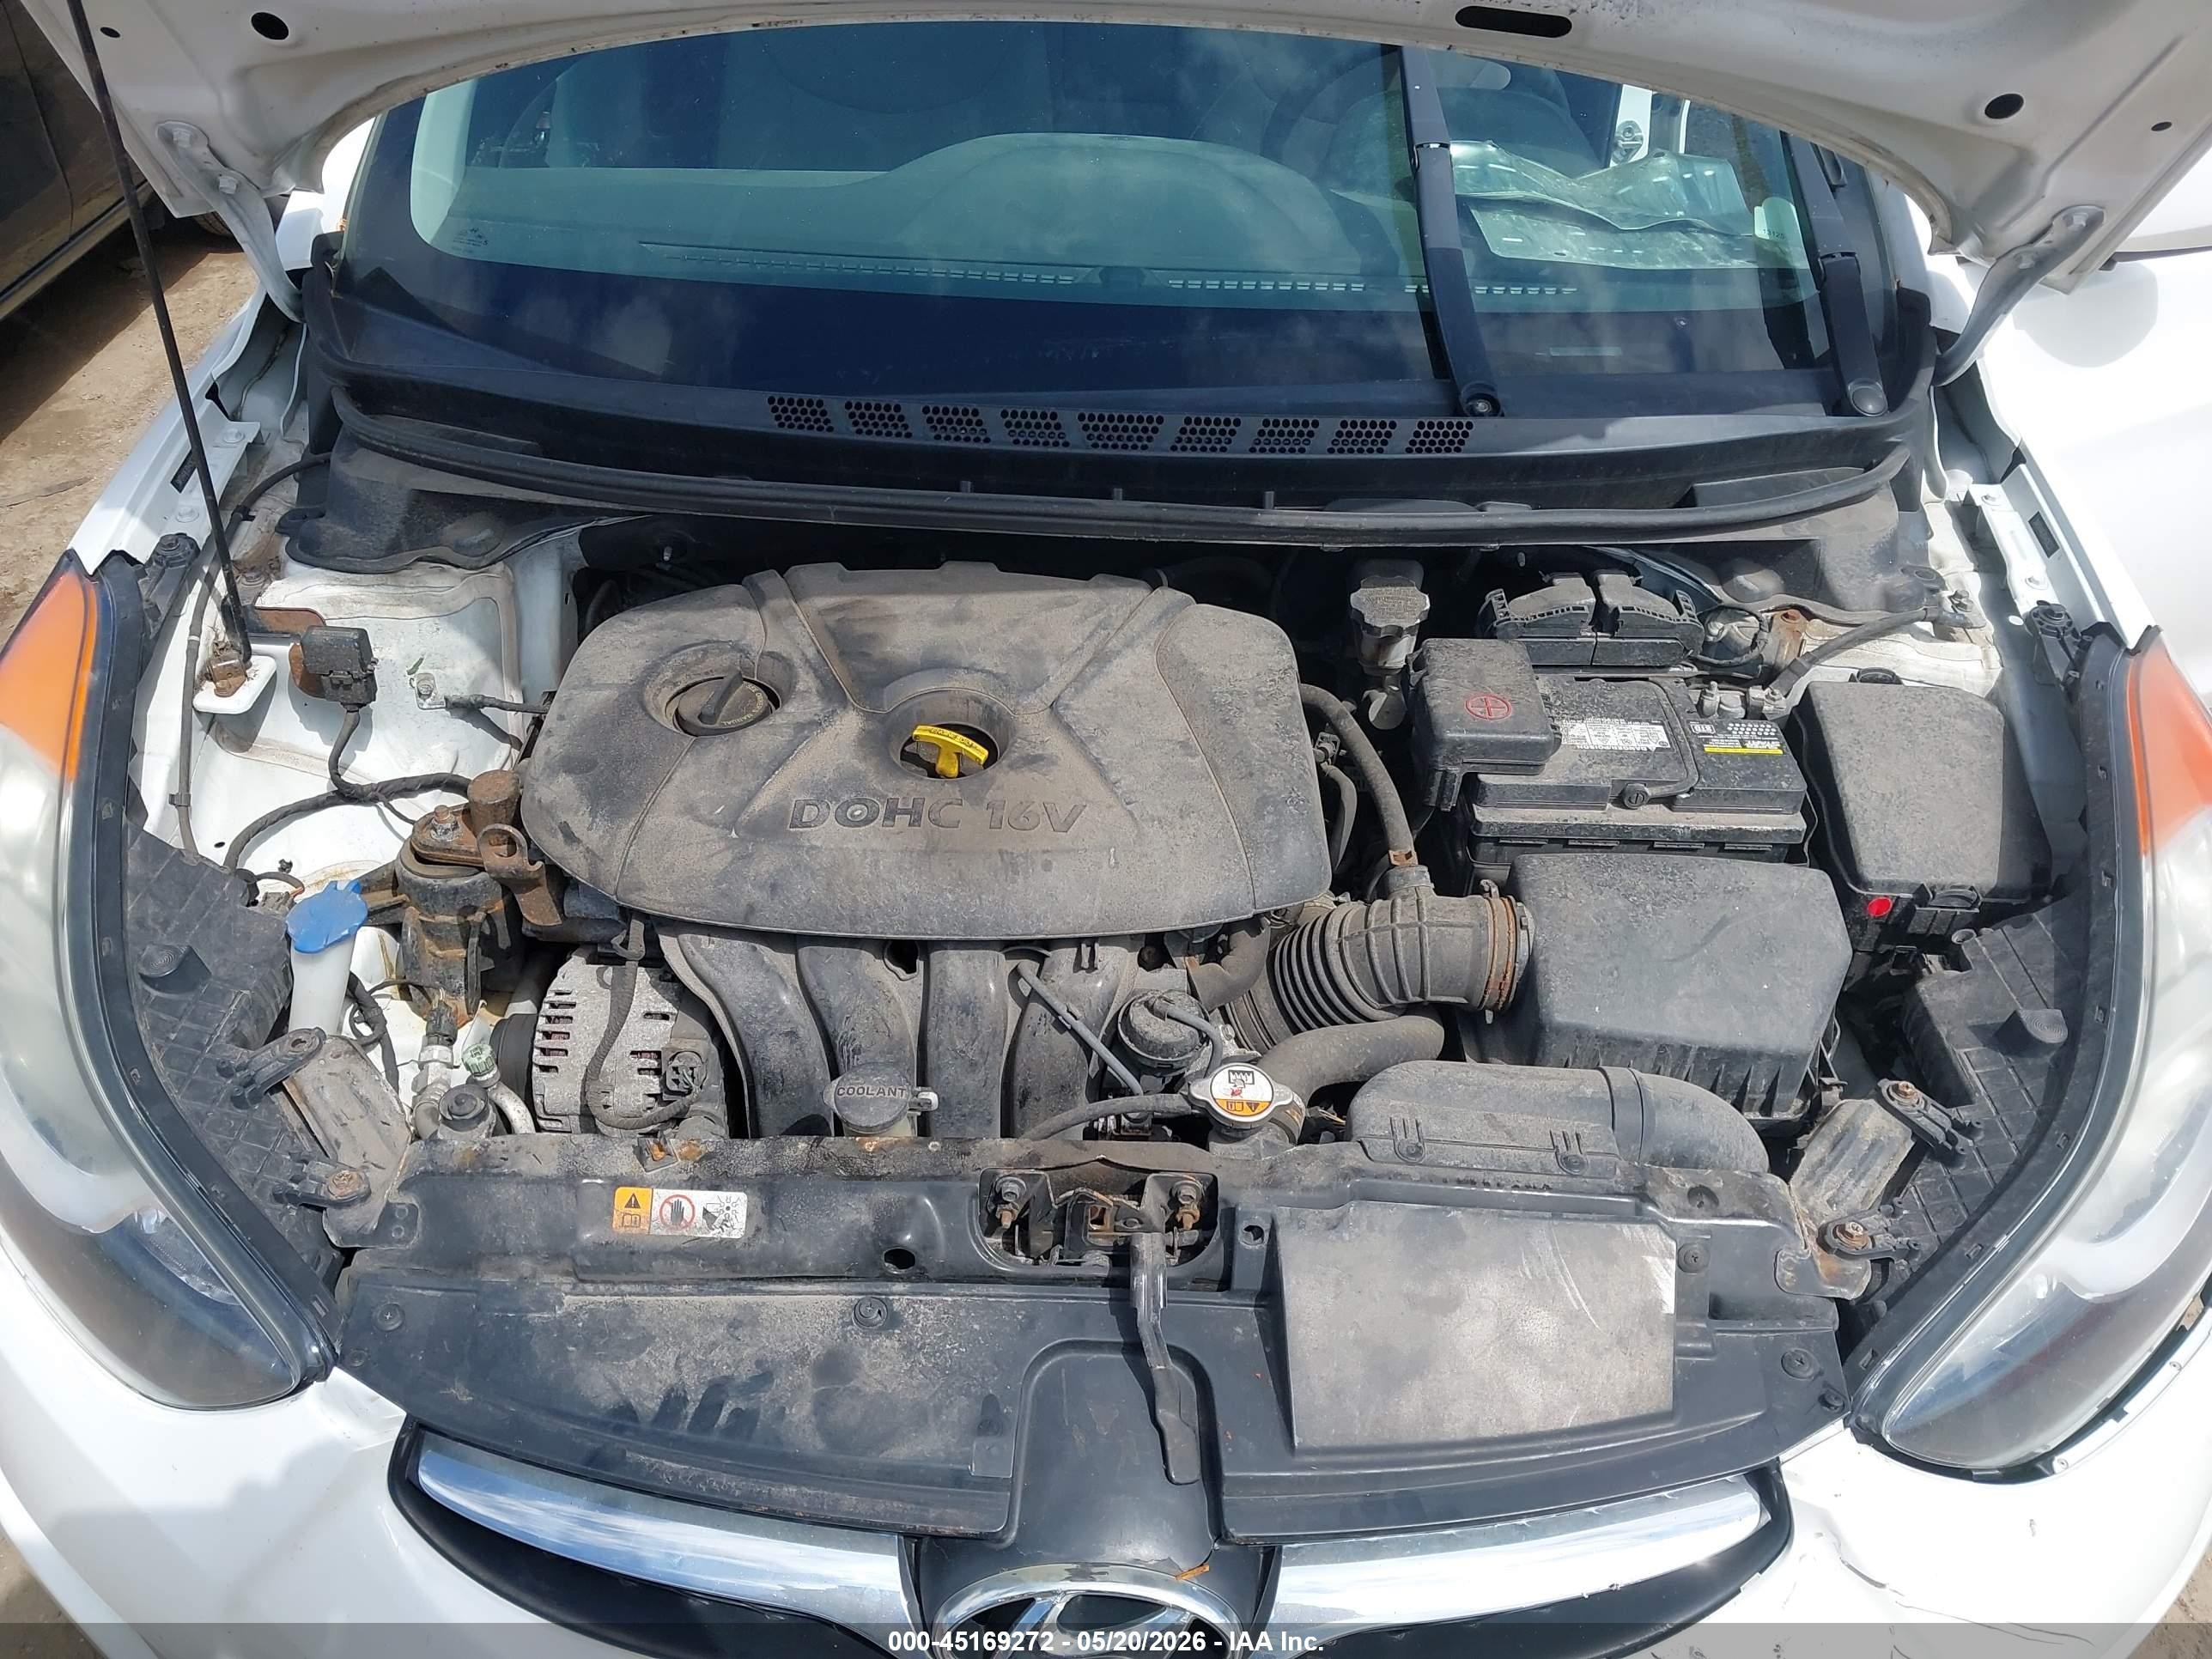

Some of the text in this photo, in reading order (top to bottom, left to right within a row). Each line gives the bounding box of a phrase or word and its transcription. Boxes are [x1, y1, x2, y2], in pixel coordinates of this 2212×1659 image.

[788, 797, 1088, 833] DOHC 16V
[836, 1085, 908, 1098] COOLANT
